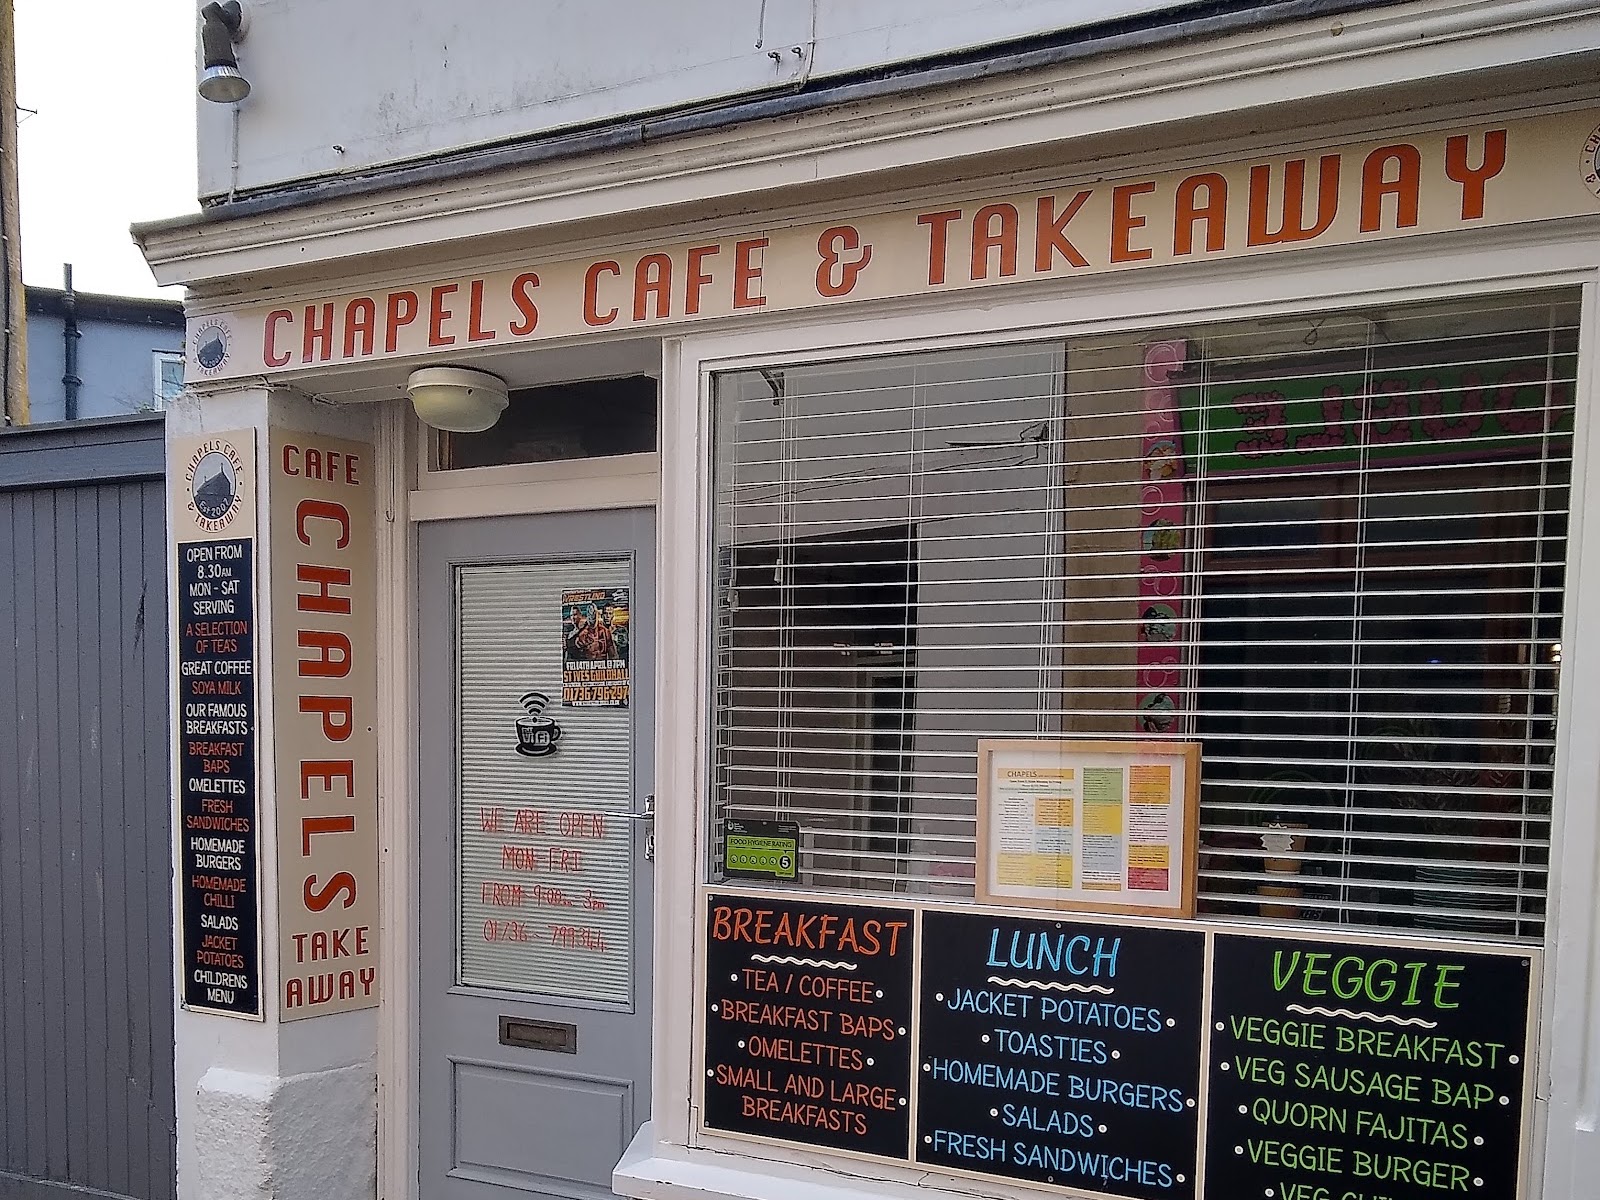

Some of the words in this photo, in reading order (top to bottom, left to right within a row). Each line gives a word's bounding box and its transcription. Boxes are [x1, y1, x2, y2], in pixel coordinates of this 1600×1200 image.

[263, 272, 541, 368] CHAPELS
[583, 237, 769, 327] CAFE
[815, 225, 873, 299] &
[917, 128, 1509, 287] TAKEAWAY
[282, 444, 360, 485] CAFE
[186, 547, 213, 562] OPEN
[214, 546, 242, 560] FROM
[189, 582, 210, 597] MON
[221, 580, 240, 595] SAT
[193, 600, 235, 615] SERVING
[186, 623, 194, 637] A
[195, 620, 248, 636] SELECTION
[196, 639, 209, 654] OF
[181, 661, 213, 676] GREAT
[214, 660, 252, 675] COFFEE
[563, 670, 572, 682] ST
[573, 670, 590, 682] IVES
[591, 668, 629, 681] GUILDHALL
[192, 680, 216, 695] SOYA
[217, 679, 242, 695] MILK
[185, 703, 207, 718] OUR
[208, 703, 247, 718] FAMOUS
[296, 499, 356, 913] CHAPELS
[185, 720, 248, 735] BREAKFASTS
[188, 742, 244, 757] BREAKFAST
[203, 759, 230, 774] BAPS
[1007, 770, 1037, 778] CHAPELS
[188, 778, 246, 794] OMELETTES
[201, 798, 234, 814] FRESH
[186, 816, 250, 832] SANDWICHES
[480, 807, 505, 833] WE
[514, 809, 547, 835] ARE
[559, 812, 605, 839] OPEN
[190, 837, 245, 854] HOMEMADE
[748, 839, 772, 847] HYGIENE
[195, 854, 242, 871] BURGERS
[502, 845, 534, 871] MON
[549, 847, 584, 872] FRI
[781, 856, 789, 868] 5
[191, 875, 247, 892] HOMEMADE
[203, 893, 235, 909] CHILLI
[481, 882, 521, 907] FROM
[200, 914, 239, 931] SALADS
[712, 906, 908, 957] BREAKFAST
[201, 935, 238, 950] JACKET
[292, 926, 369, 963] TAKE
[196, 950, 244, 968] POTATOES
[986, 927, 1121, 978] LUNCH
[193, 969, 248, 989] CHILDRENS
[286, 967, 375, 1010] AWAY
[741, 968, 779, 993] TEA
[785, 973, 793, 994] /
[799, 974, 875, 1004] COFFEE
[1272, 950, 1466, 1009] VEGGIE
[207, 988, 235, 1005] MENU
[947, 987, 1034, 1019] JACKET
[1041, 997, 1162, 1033] POTATOES
[721, 999, 833, 1033] BREAKFAST
[839, 1013, 895, 1041] BAPS
[994, 1028, 1107, 1065] TOASTIES
[1230, 1015, 1326, 1050] VEGGIE
[1336, 1027, 1505, 1070] BREAKFAST
[748, 1035, 863, 1072] OMELETTES
[716, 1064, 779, 1093] SMALL
[784, 1074, 824, 1099] AND
[830, 1079, 897, 1111] LARGE
[933, 1057, 1060, 1096] HOMEMADE
[1068, 1075, 1184, 1113] BURGERS
[1235, 1055, 1285, 1086] VEG
[1295, 1062, 1422, 1103] SAUSAGE
[1431, 1079, 1494, 1110] BAP
[741, 1095, 868, 1136] BREAKFASTS
[1002, 1103, 1094, 1138] SALADS
[1252, 1097, 1347, 1134] QUORN
[1356, 1110, 1468, 1150] FAJITAS
[933, 1130, 1006, 1163] FRESH
[1013, 1142, 1174, 1188] SANDWICHES
[1247, 1138, 1343, 1174] VEGGIE
[1352, 1151, 1470, 1192] BURGER
